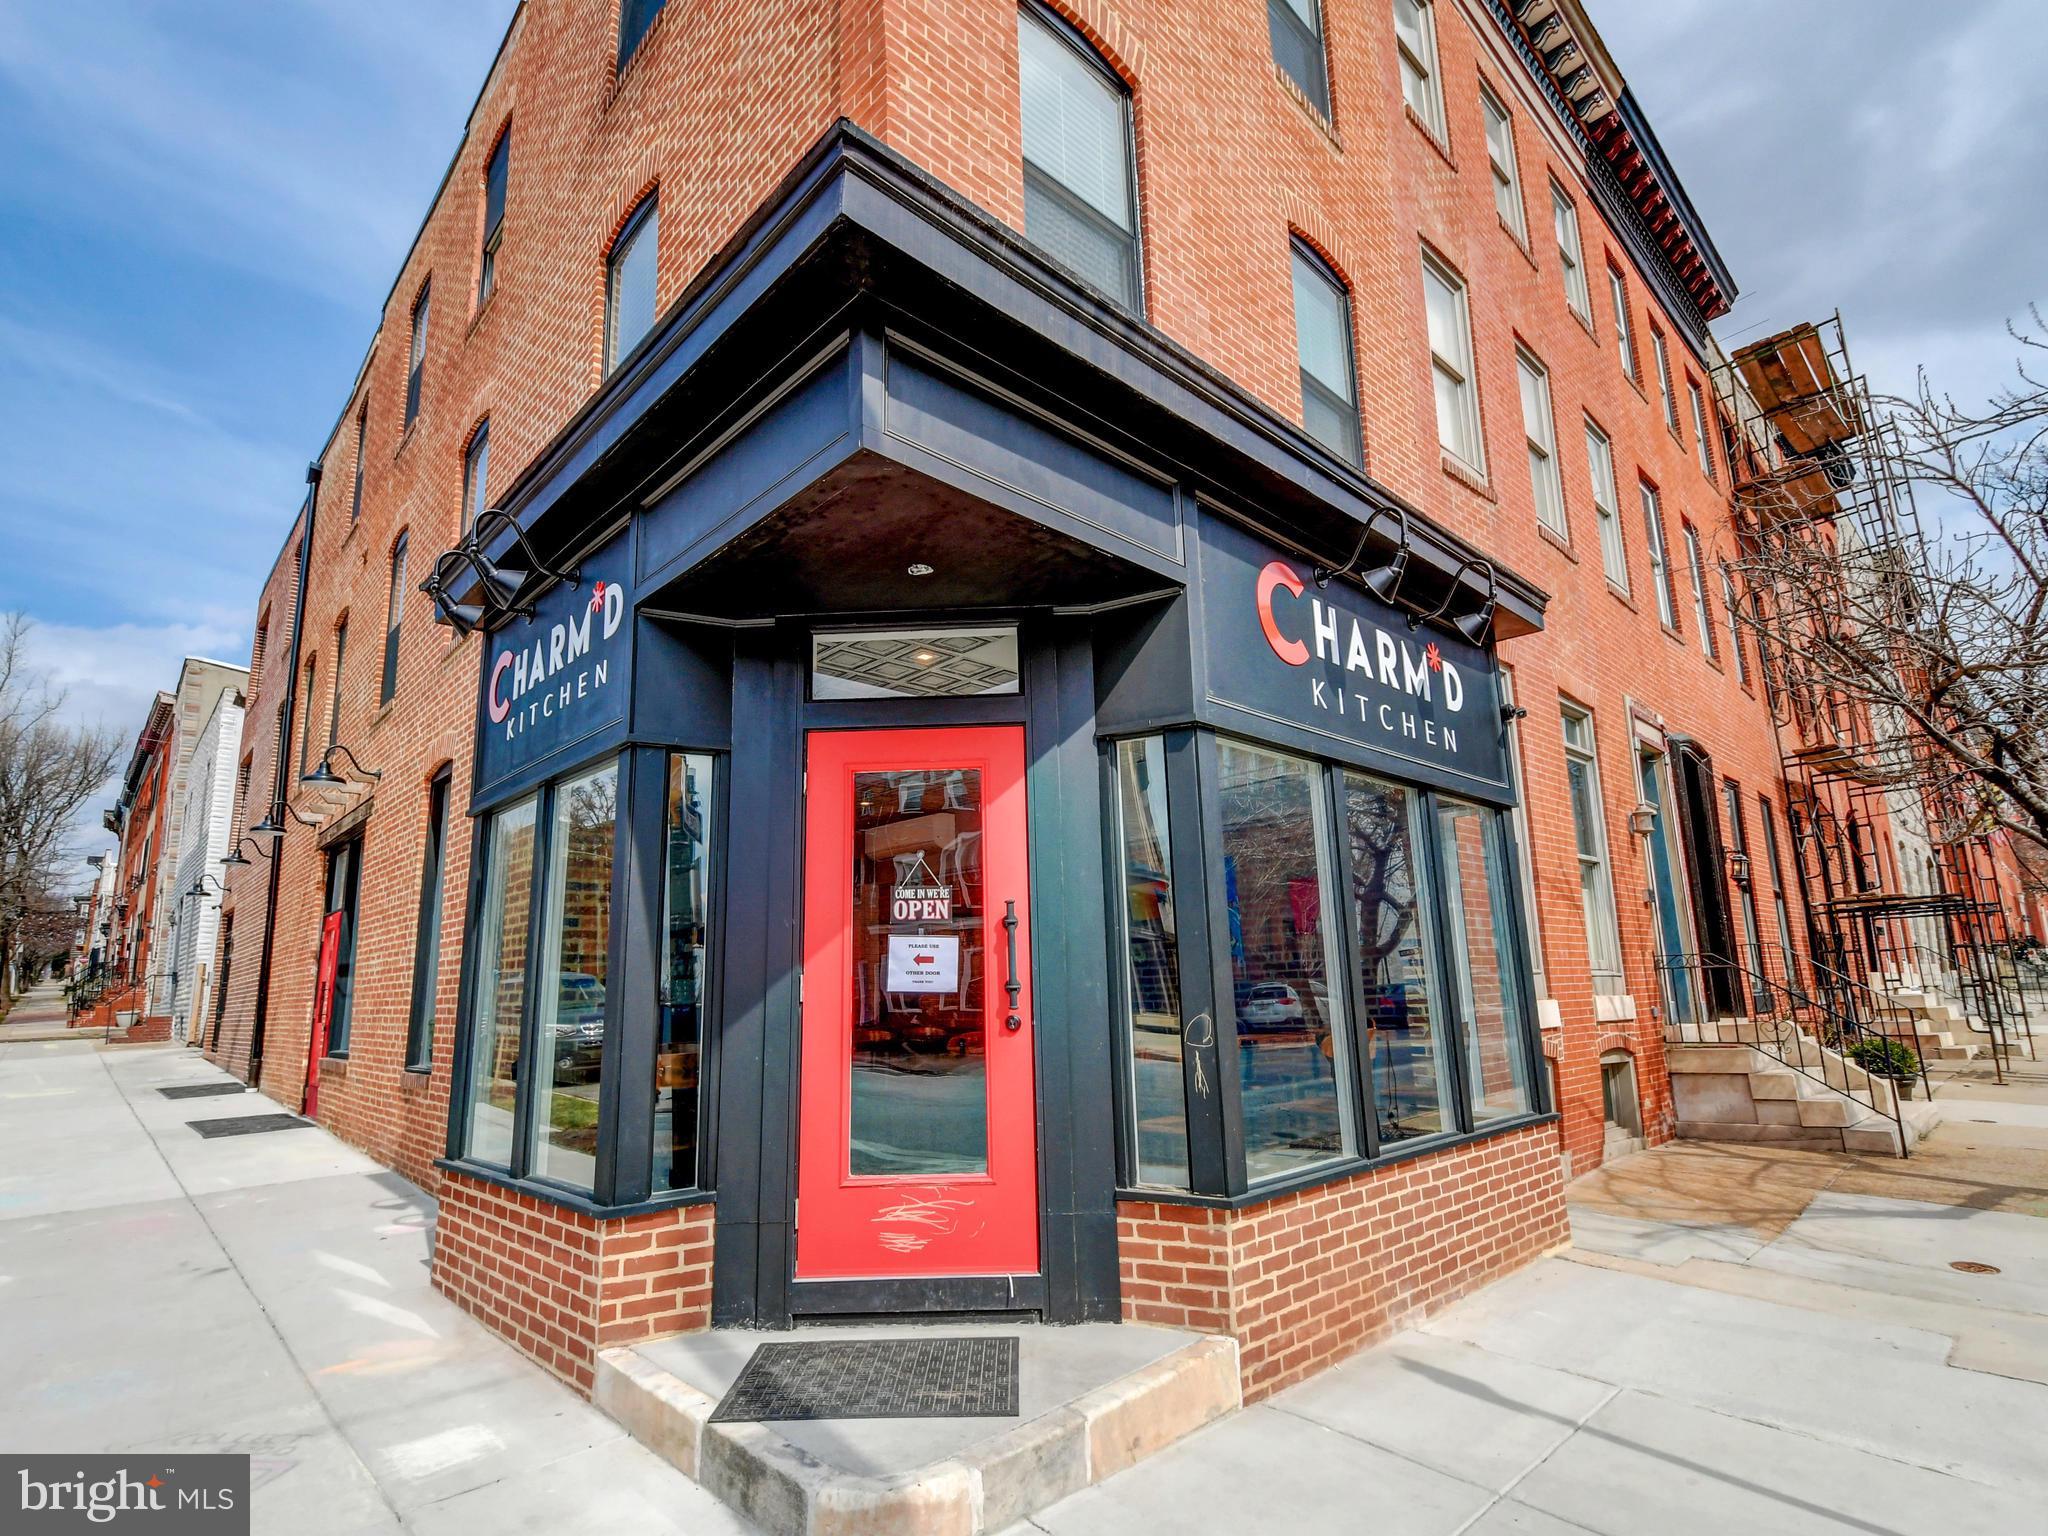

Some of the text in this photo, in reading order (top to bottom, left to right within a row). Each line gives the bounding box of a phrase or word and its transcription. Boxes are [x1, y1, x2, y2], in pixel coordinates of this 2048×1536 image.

[506, 659, 608, 741] KITCHEN
[1311, 678, 1458, 753] KITCHEN
[893, 899, 950, 920] OPEN
[895, 888, 916, 899] COME
[917, 888, 926, 899] IN
